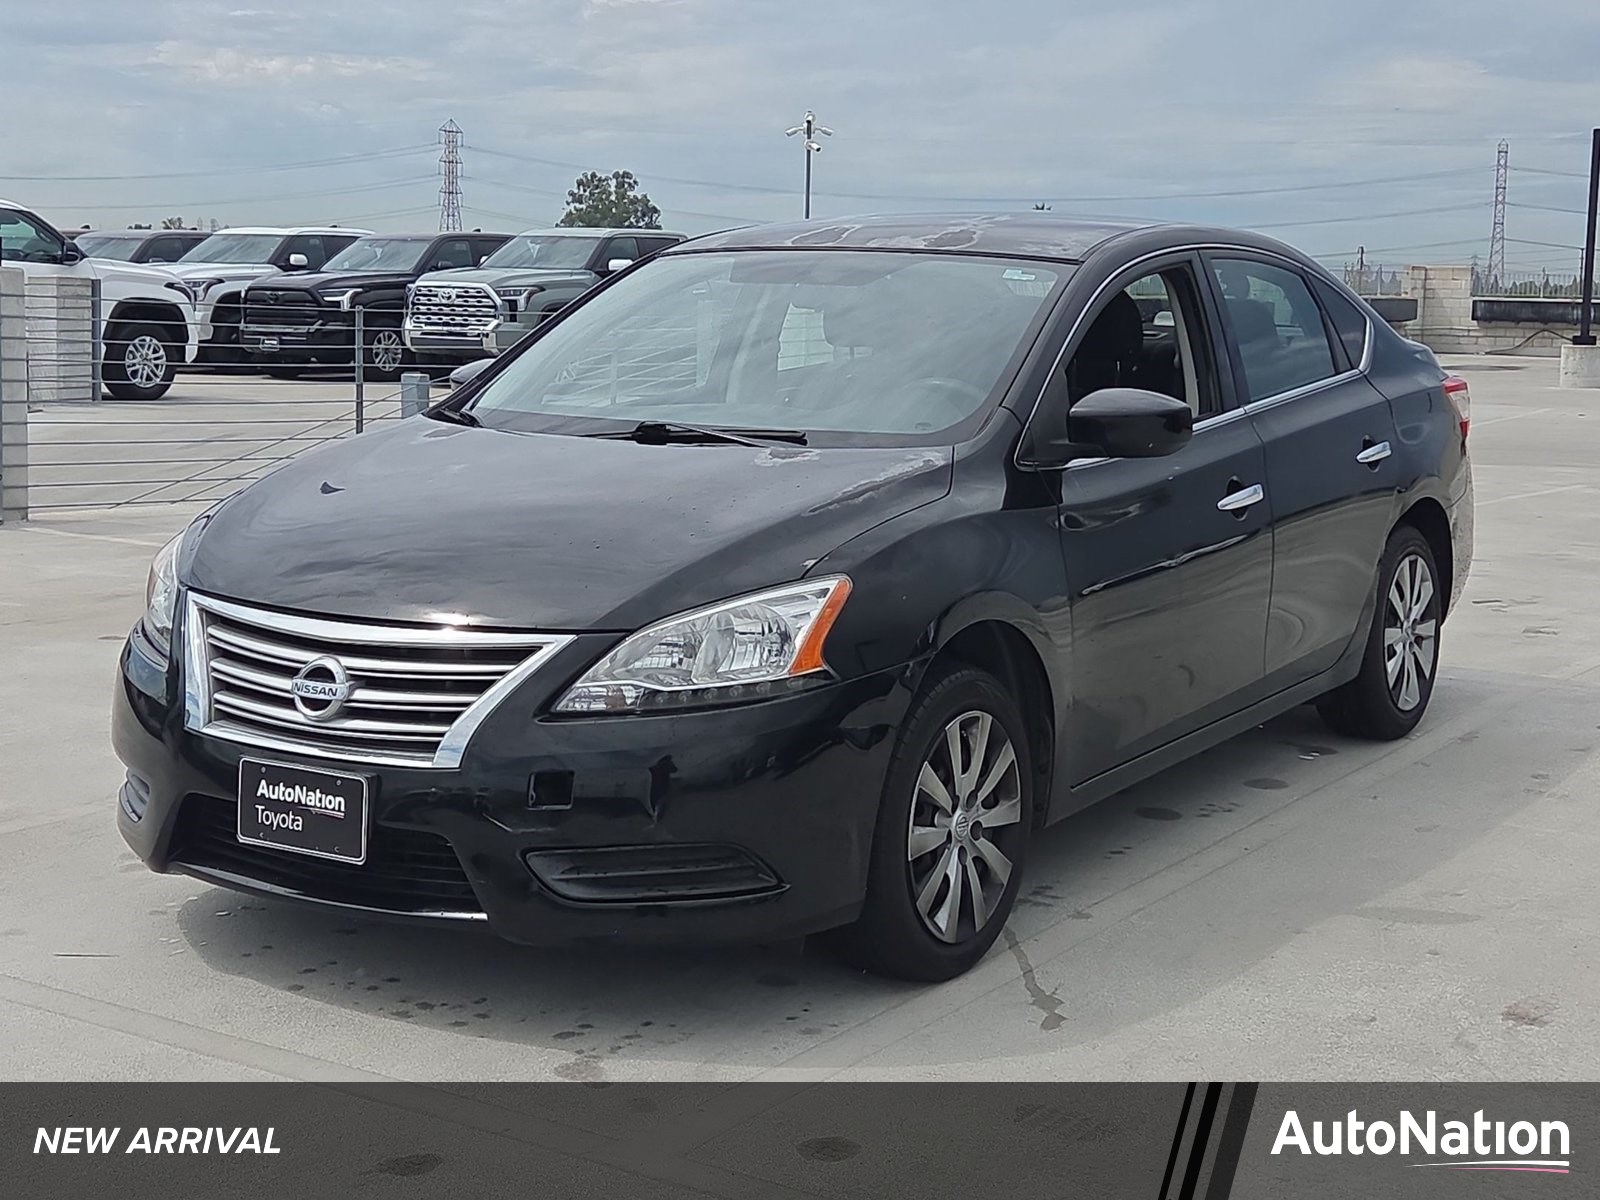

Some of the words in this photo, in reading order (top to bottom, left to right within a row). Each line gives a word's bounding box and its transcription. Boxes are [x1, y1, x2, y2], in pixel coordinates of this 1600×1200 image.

[293, 682, 338, 697] NISSAN
[256, 779, 345, 812] AutoNation
[255, 804, 303, 831] Toyota
